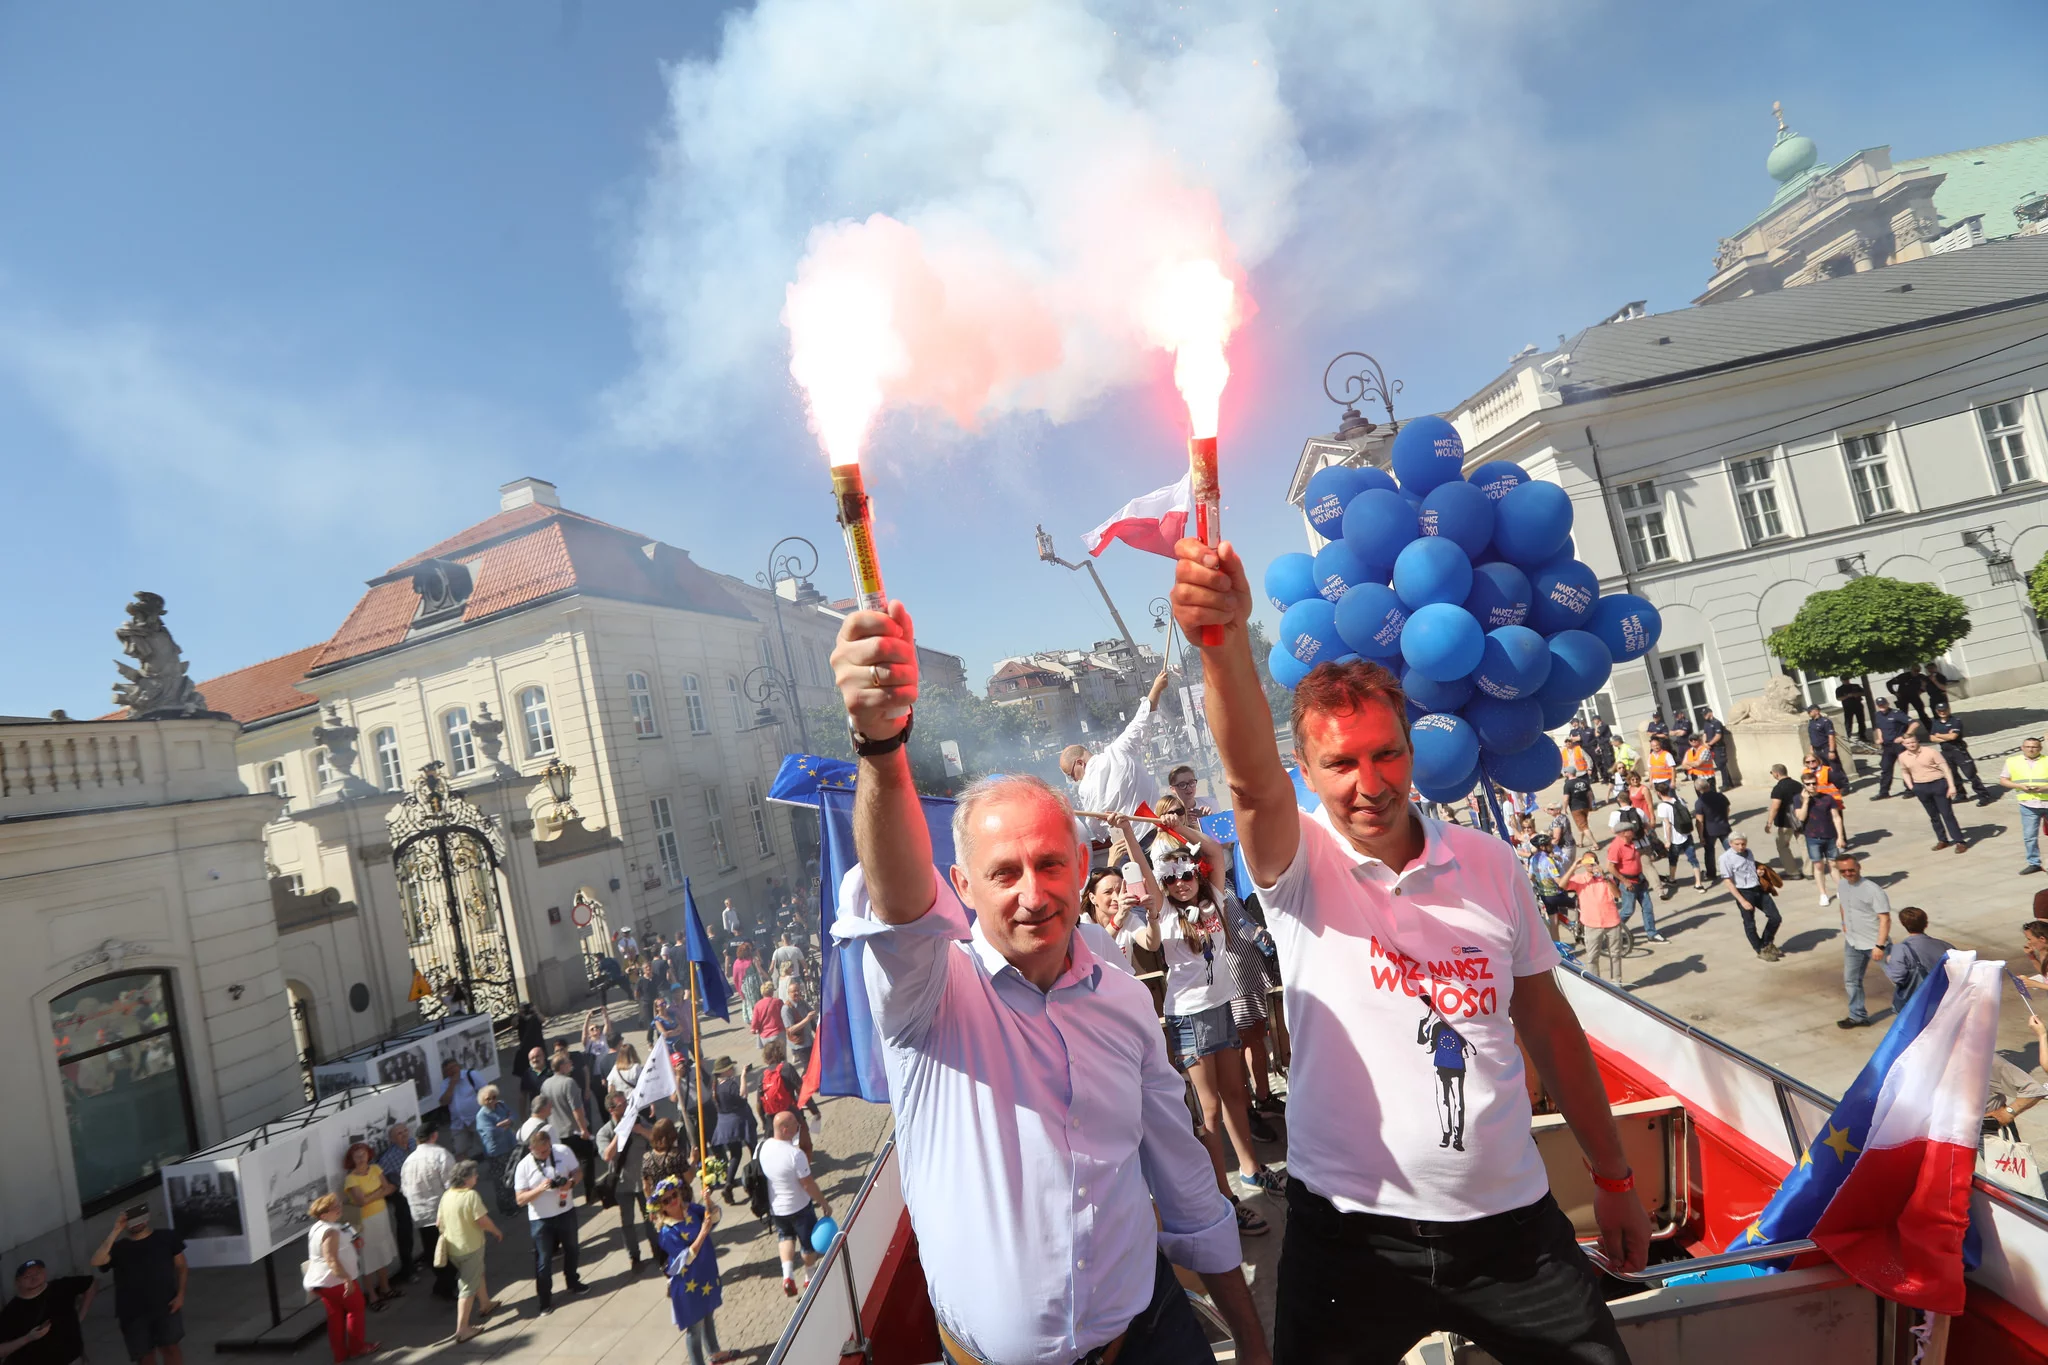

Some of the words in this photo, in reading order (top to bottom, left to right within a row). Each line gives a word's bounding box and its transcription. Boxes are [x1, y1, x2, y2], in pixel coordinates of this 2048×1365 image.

[1434, 439, 1453, 447] MARSZ
[1481, 481, 1501, 492] MARSZ
[1501, 478, 1519, 486] MARSZ
[1323, 497, 1340, 509] MARSZ
[853, 523, 864, 557] ŚWIETLN
[1555, 582, 1577, 598] MARSZ
[1491, 606, 1513, 617] MARSZ
[1428, 957, 1494, 981] MARSZ
[1995, 1153, 2025, 1179] H&M
